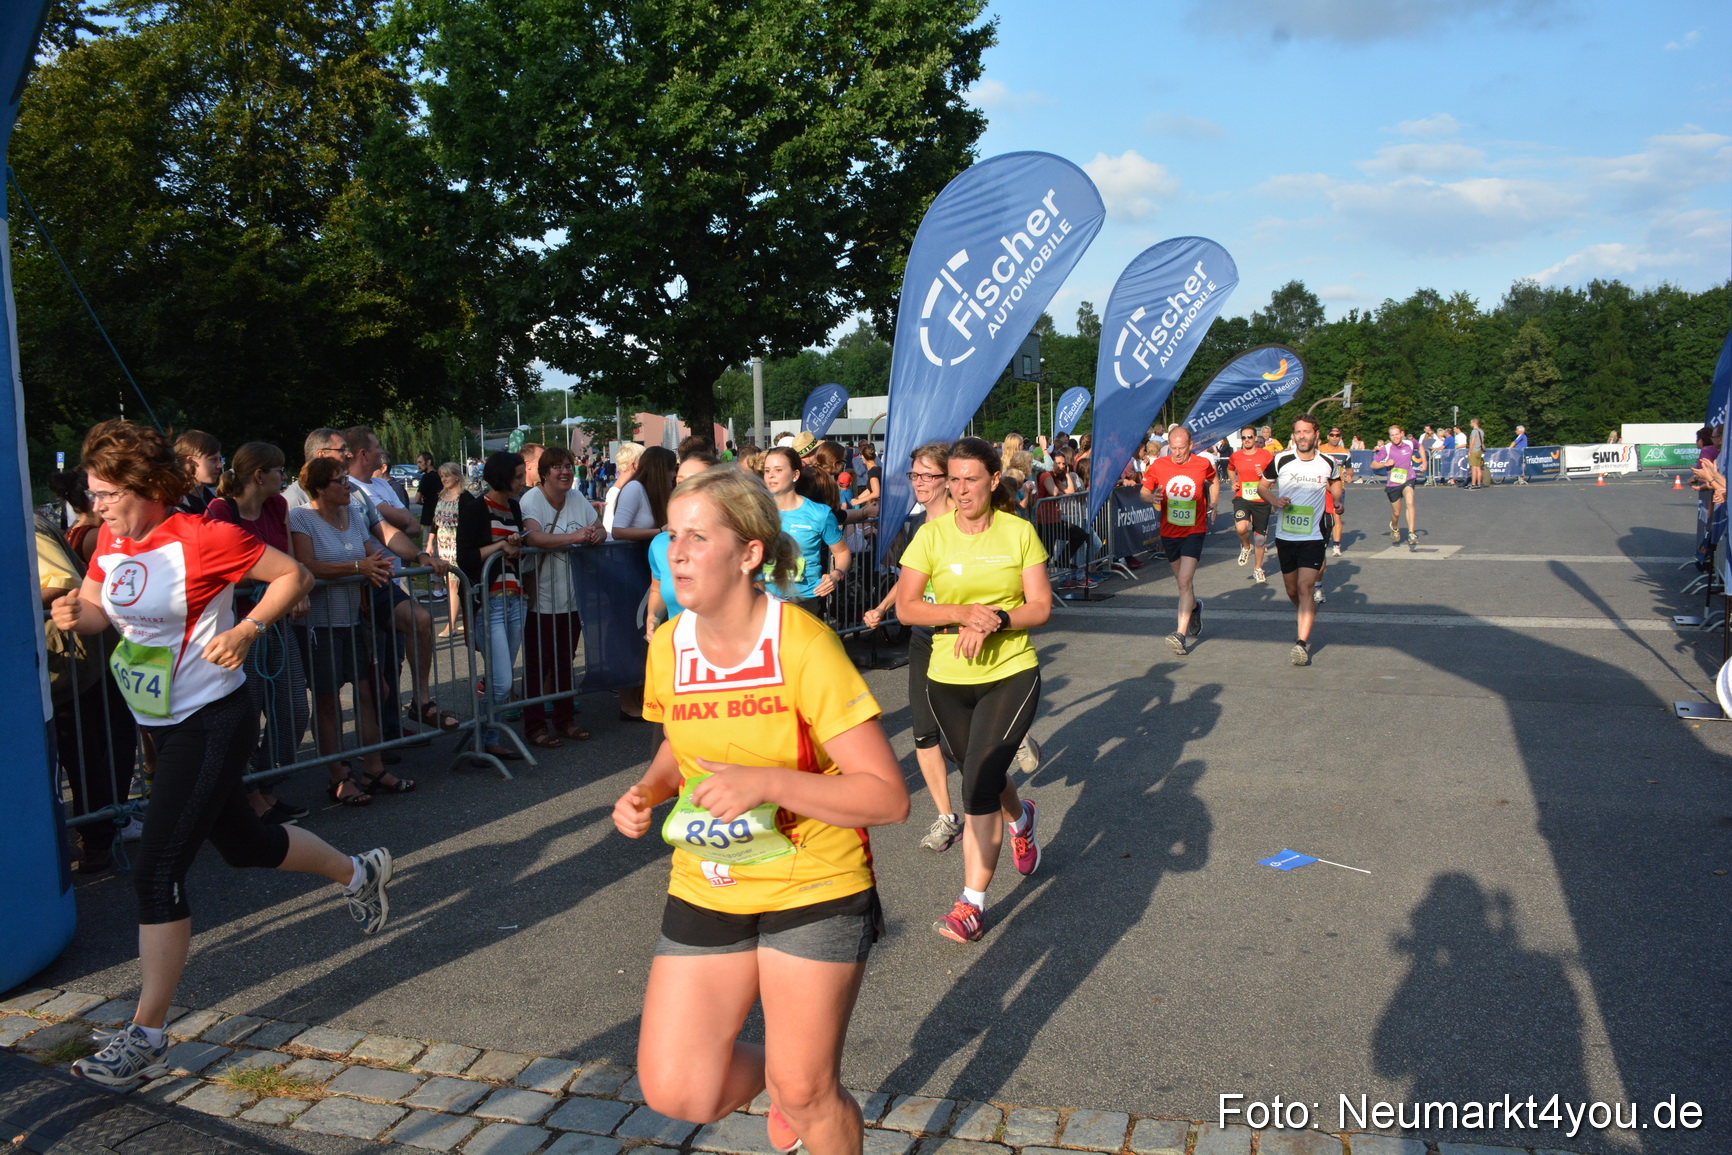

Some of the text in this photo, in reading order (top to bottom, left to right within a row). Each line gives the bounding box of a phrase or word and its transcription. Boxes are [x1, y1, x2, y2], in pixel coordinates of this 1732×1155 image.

[947, 188, 1059, 341] Fischer
[987, 218, 1072, 340] AUTOMOBILE
[1132, 260, 1207, 370] Fischer
[1159, 280, 1217, 368] AUTOMOBILE
[812, 391, 839, 427] Fischer
[1063, 393, 1084, 423] Fischer
[1188, 381, 1272, 433] Frischmann
[1241, 396, 1262, 412] Druck
[1275, 376, 1300, 394] Medien
[1644, 448, 1667, 459] AOK
[1169, 482, 1192, 498] 48
[1117, 505, 1156, 528] Frischmann
[1172, 509, 1191, 520] 503
[1285, 515, 1310, 527] 1605
[113, 662, 162, 699] 1674
[671, 693, 789, 721] MAX BÖGL
[685, 818, 754, 850] 859
